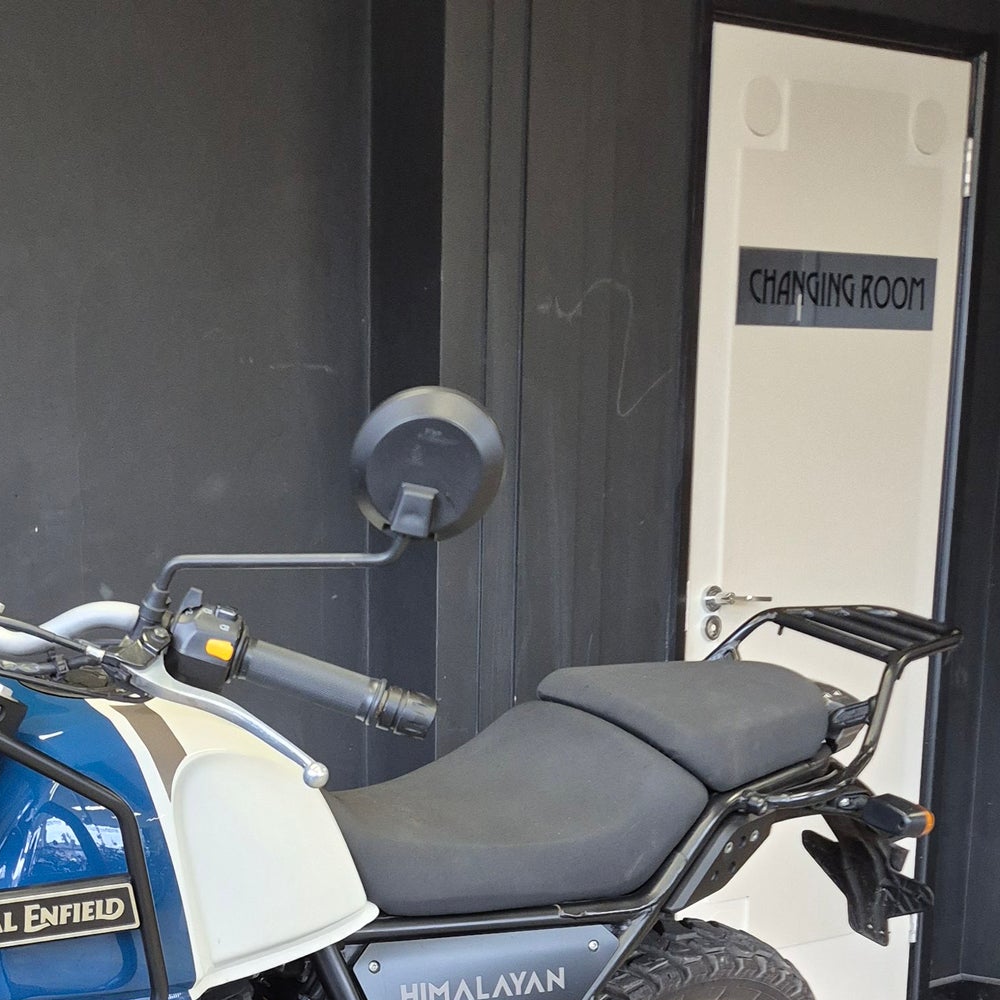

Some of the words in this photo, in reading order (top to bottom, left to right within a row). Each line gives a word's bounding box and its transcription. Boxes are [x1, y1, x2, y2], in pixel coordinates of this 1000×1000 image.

[750, 269, 855, 307] CHANGING
[860, 274, 925, 311] ROOM
[23, 897, 125, 933] ENFIELD
